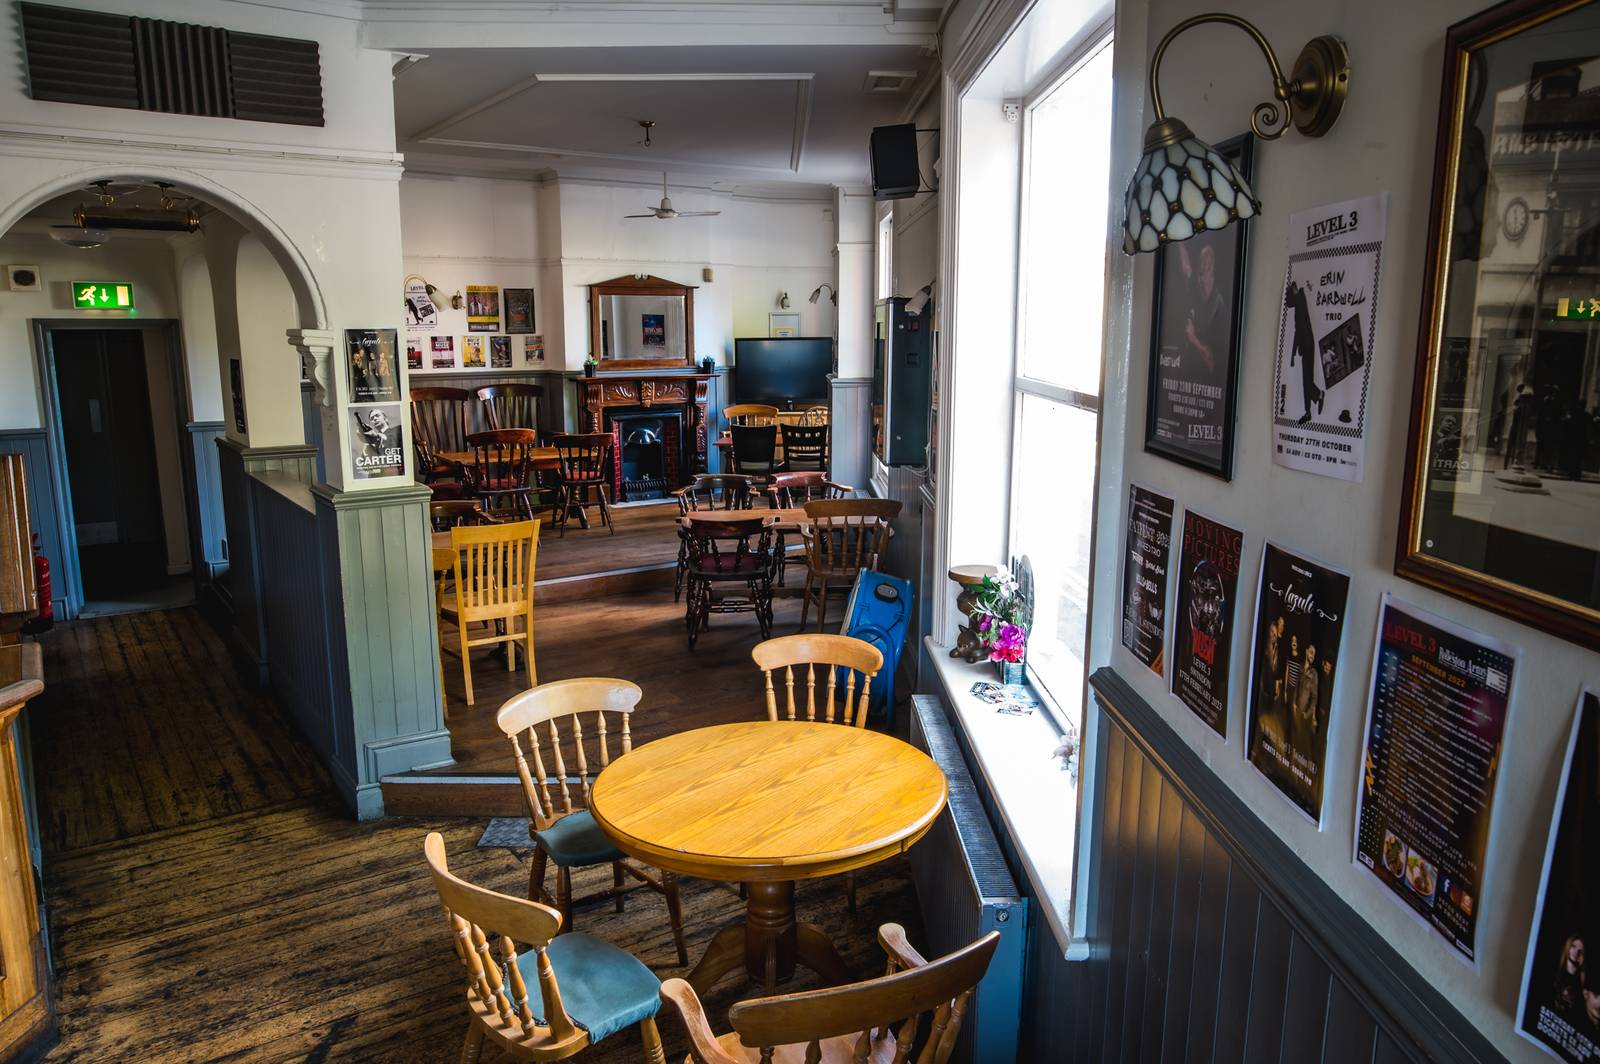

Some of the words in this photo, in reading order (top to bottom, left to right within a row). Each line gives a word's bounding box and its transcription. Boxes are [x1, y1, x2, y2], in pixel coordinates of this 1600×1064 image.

[1306, 215, 1346, 241] LEVEL
[1349, 210, 1358, 227] 3
[1320, 270, 1345, 287] ERIN
[1316, 288, 1365, 306] BARDWELL
[1326, 312, 1342, 320] TRIO
[1193, 383, 1222, 399] SEPTEMBER
[1188, 424, 1217, 439] LEVEL
[1217, 426, 1223, 441] 3
[1279, 432, 1304, 444] THURSDAY
[1305, 438, 1320, 447] 27TH
[1321, 441, 1352, 453] OCTOBER
[355, 455, 402, 466] CARTER
[385, 447, 401, 455] GET
[1186, 516, 1241, 554] MOVING
[1184, 534, 1240, 572] PICTURES
[1284, 583, 1314, 613] lazuli
[1386, 623, 1426, 649] LEVEL
[1428, 636, 1437, 654] 3
[1193, 656, 1207, 674] LEVEL
[1207, 667, 1211, 676] 3
[1411, 655, 1447, 678] SEPTEMBER
[1447, 675, 1467, 688] 2022
[1190, 666, 1212, 689] SWINDON
[1190, 678, 1212, 702] FEBRUARY
[1211, 696, 1223, 711] 2023
